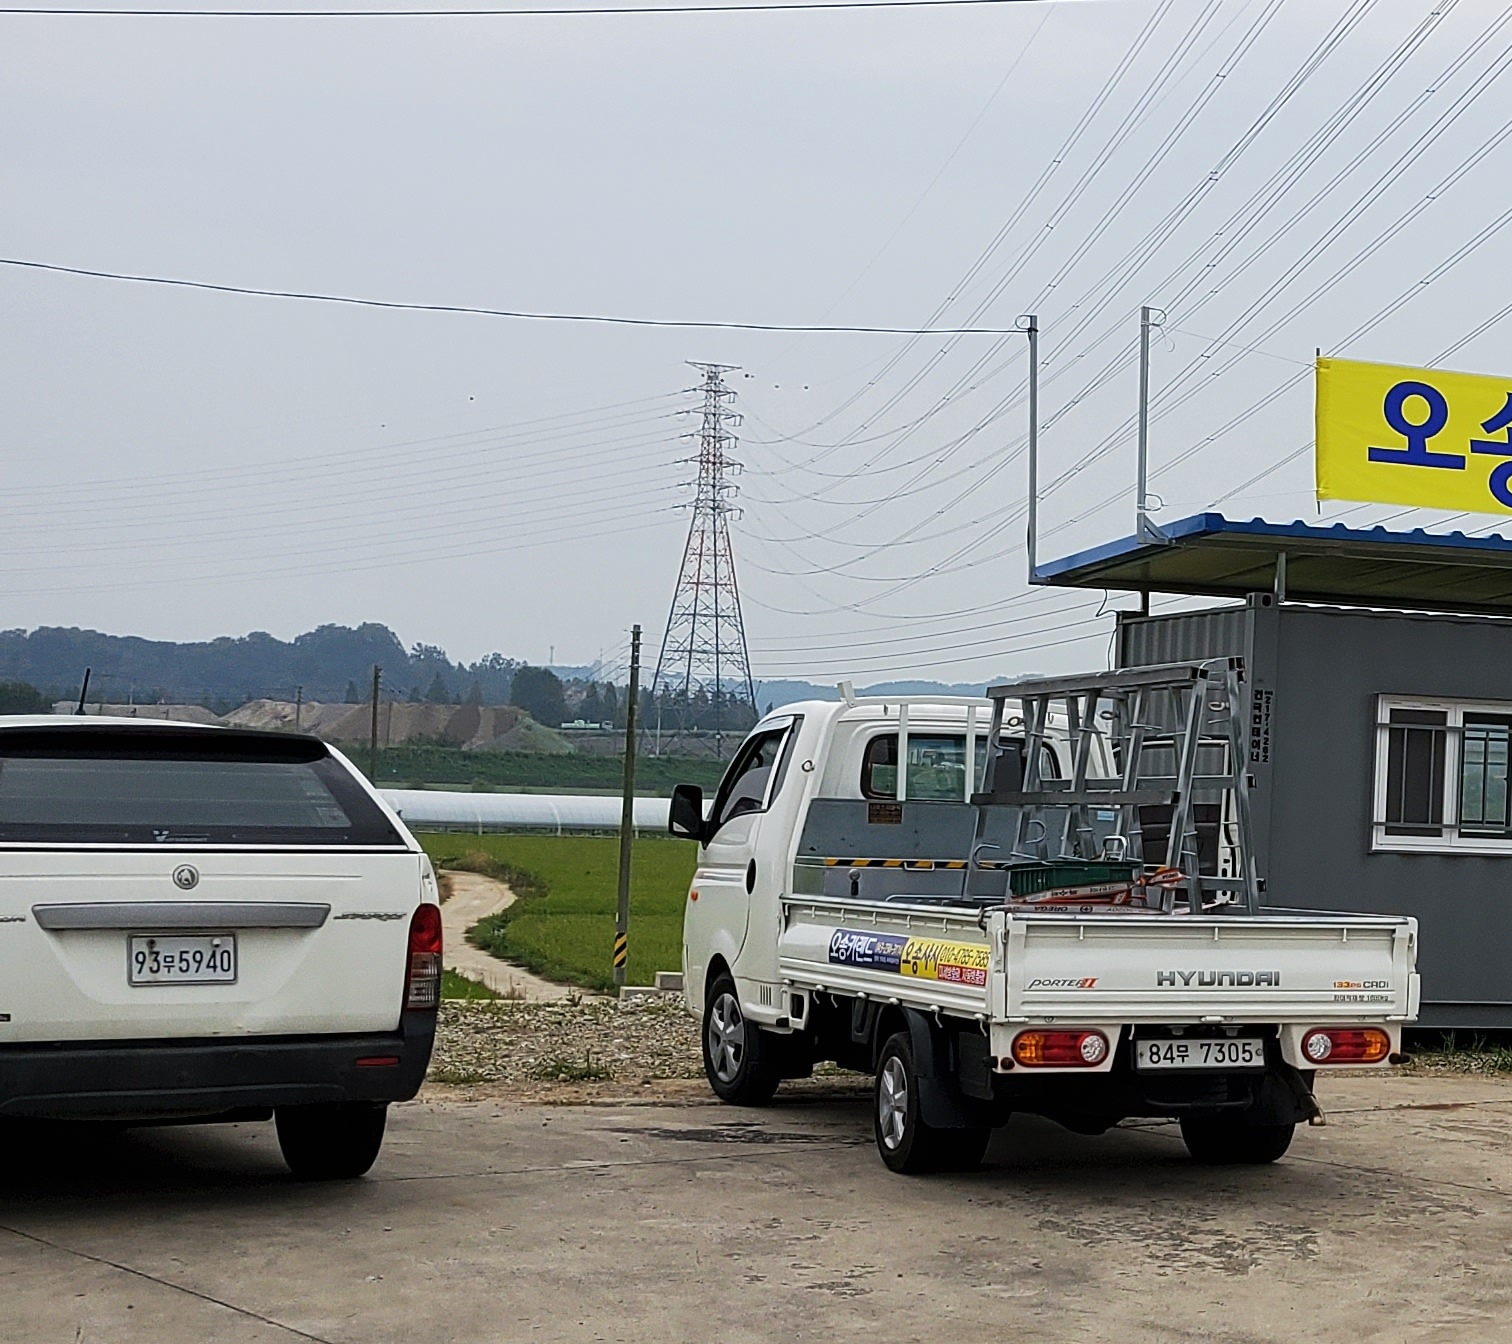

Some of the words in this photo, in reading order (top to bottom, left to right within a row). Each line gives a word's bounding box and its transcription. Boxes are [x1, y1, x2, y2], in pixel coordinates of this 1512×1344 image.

[135, 949, 232, 975] 93무5940
[1157, 971, 1280, 987] HYUNDAI
[1149, 1042, 1190, 1065] 84무
[1199, 1042, 1253, 1065] 7305
